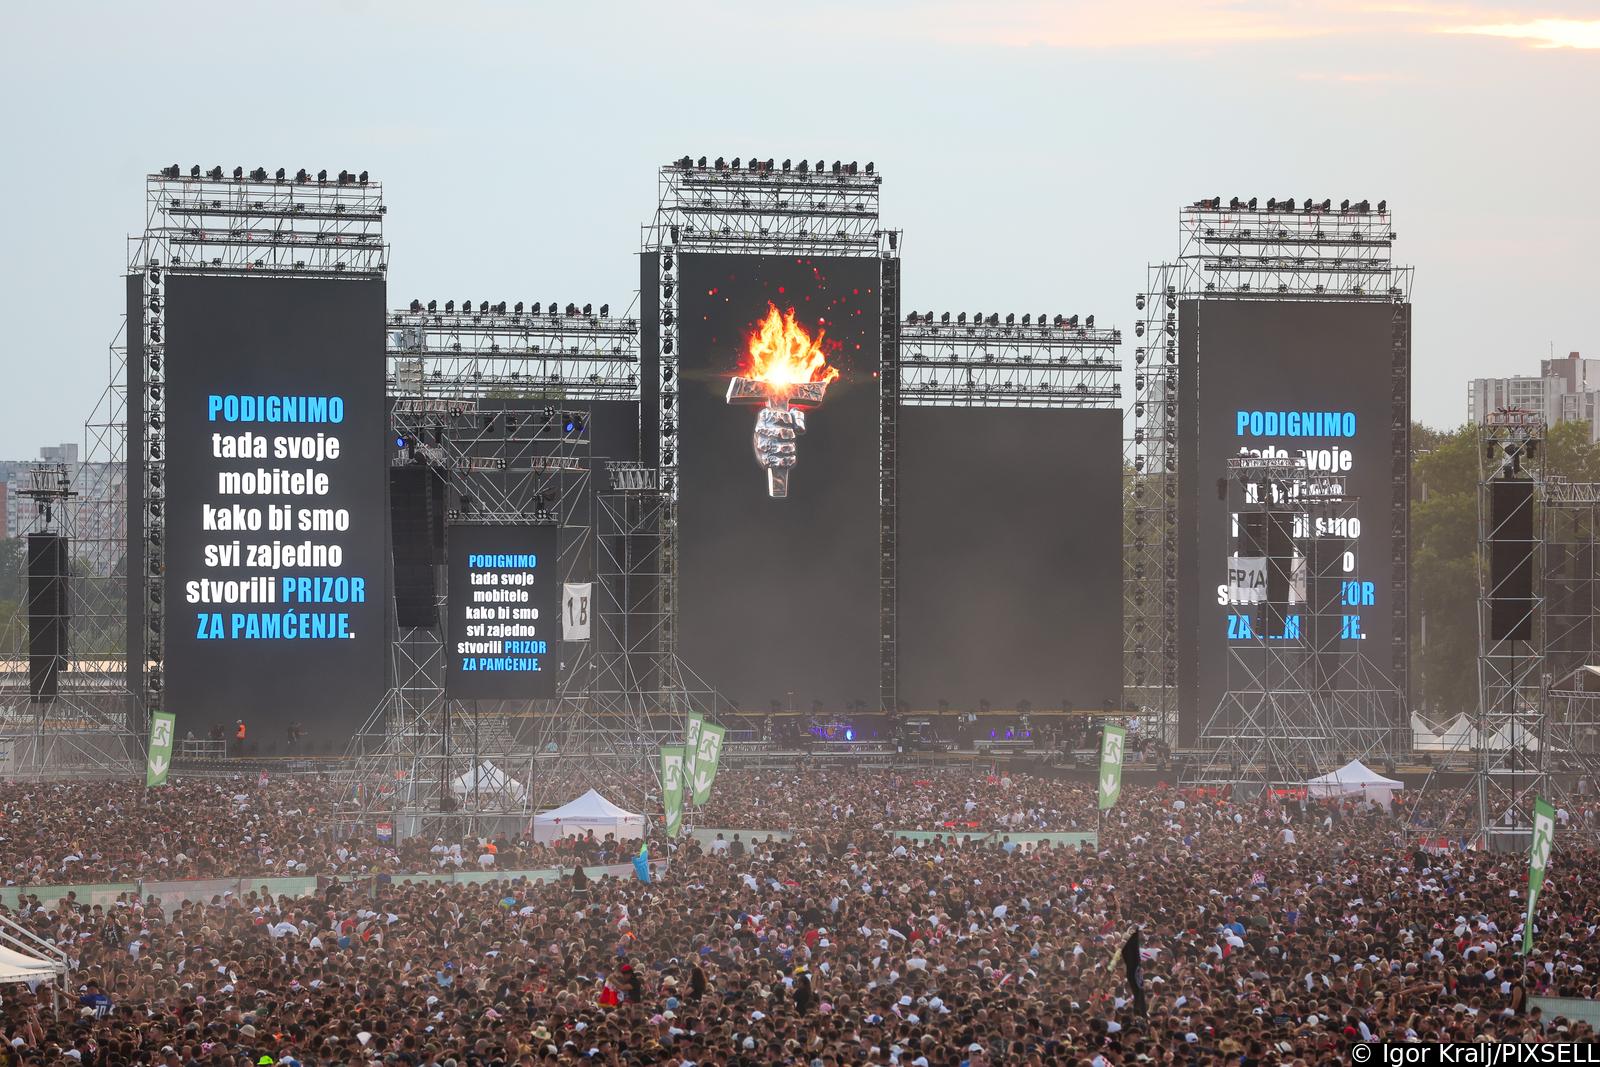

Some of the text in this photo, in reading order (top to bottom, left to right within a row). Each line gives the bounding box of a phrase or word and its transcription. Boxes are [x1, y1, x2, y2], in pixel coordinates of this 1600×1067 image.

[208, 395, 344, 423] PODIGNIMO
[1237, 411, 1356, 437] PODIGNIMO
[212, 432, 340, 461] tada svoje
[218, 468, 329, 495] mobitele
[203, 504, 350, 532] kako bi smo
[204, 541, 343, 569] svi zajedno
[469, 554, 537, 568] PODIGNIMO
[186, 577, 365, 603] stvorili PRIZOR
[471, 572, 535, 586] tada svoje
[473, 589, 529, 602] mobitele
[196, 609, 356, 640] ZA PAMĆENJE.
[466, 606, 539, 619] kako bi smo
[467, 624, 536, 638] svi zajedno
[458, 641, 547, 654] stvorili PRIZOR
[463, 656, 542, 671] ZA PAMĆENJE.
